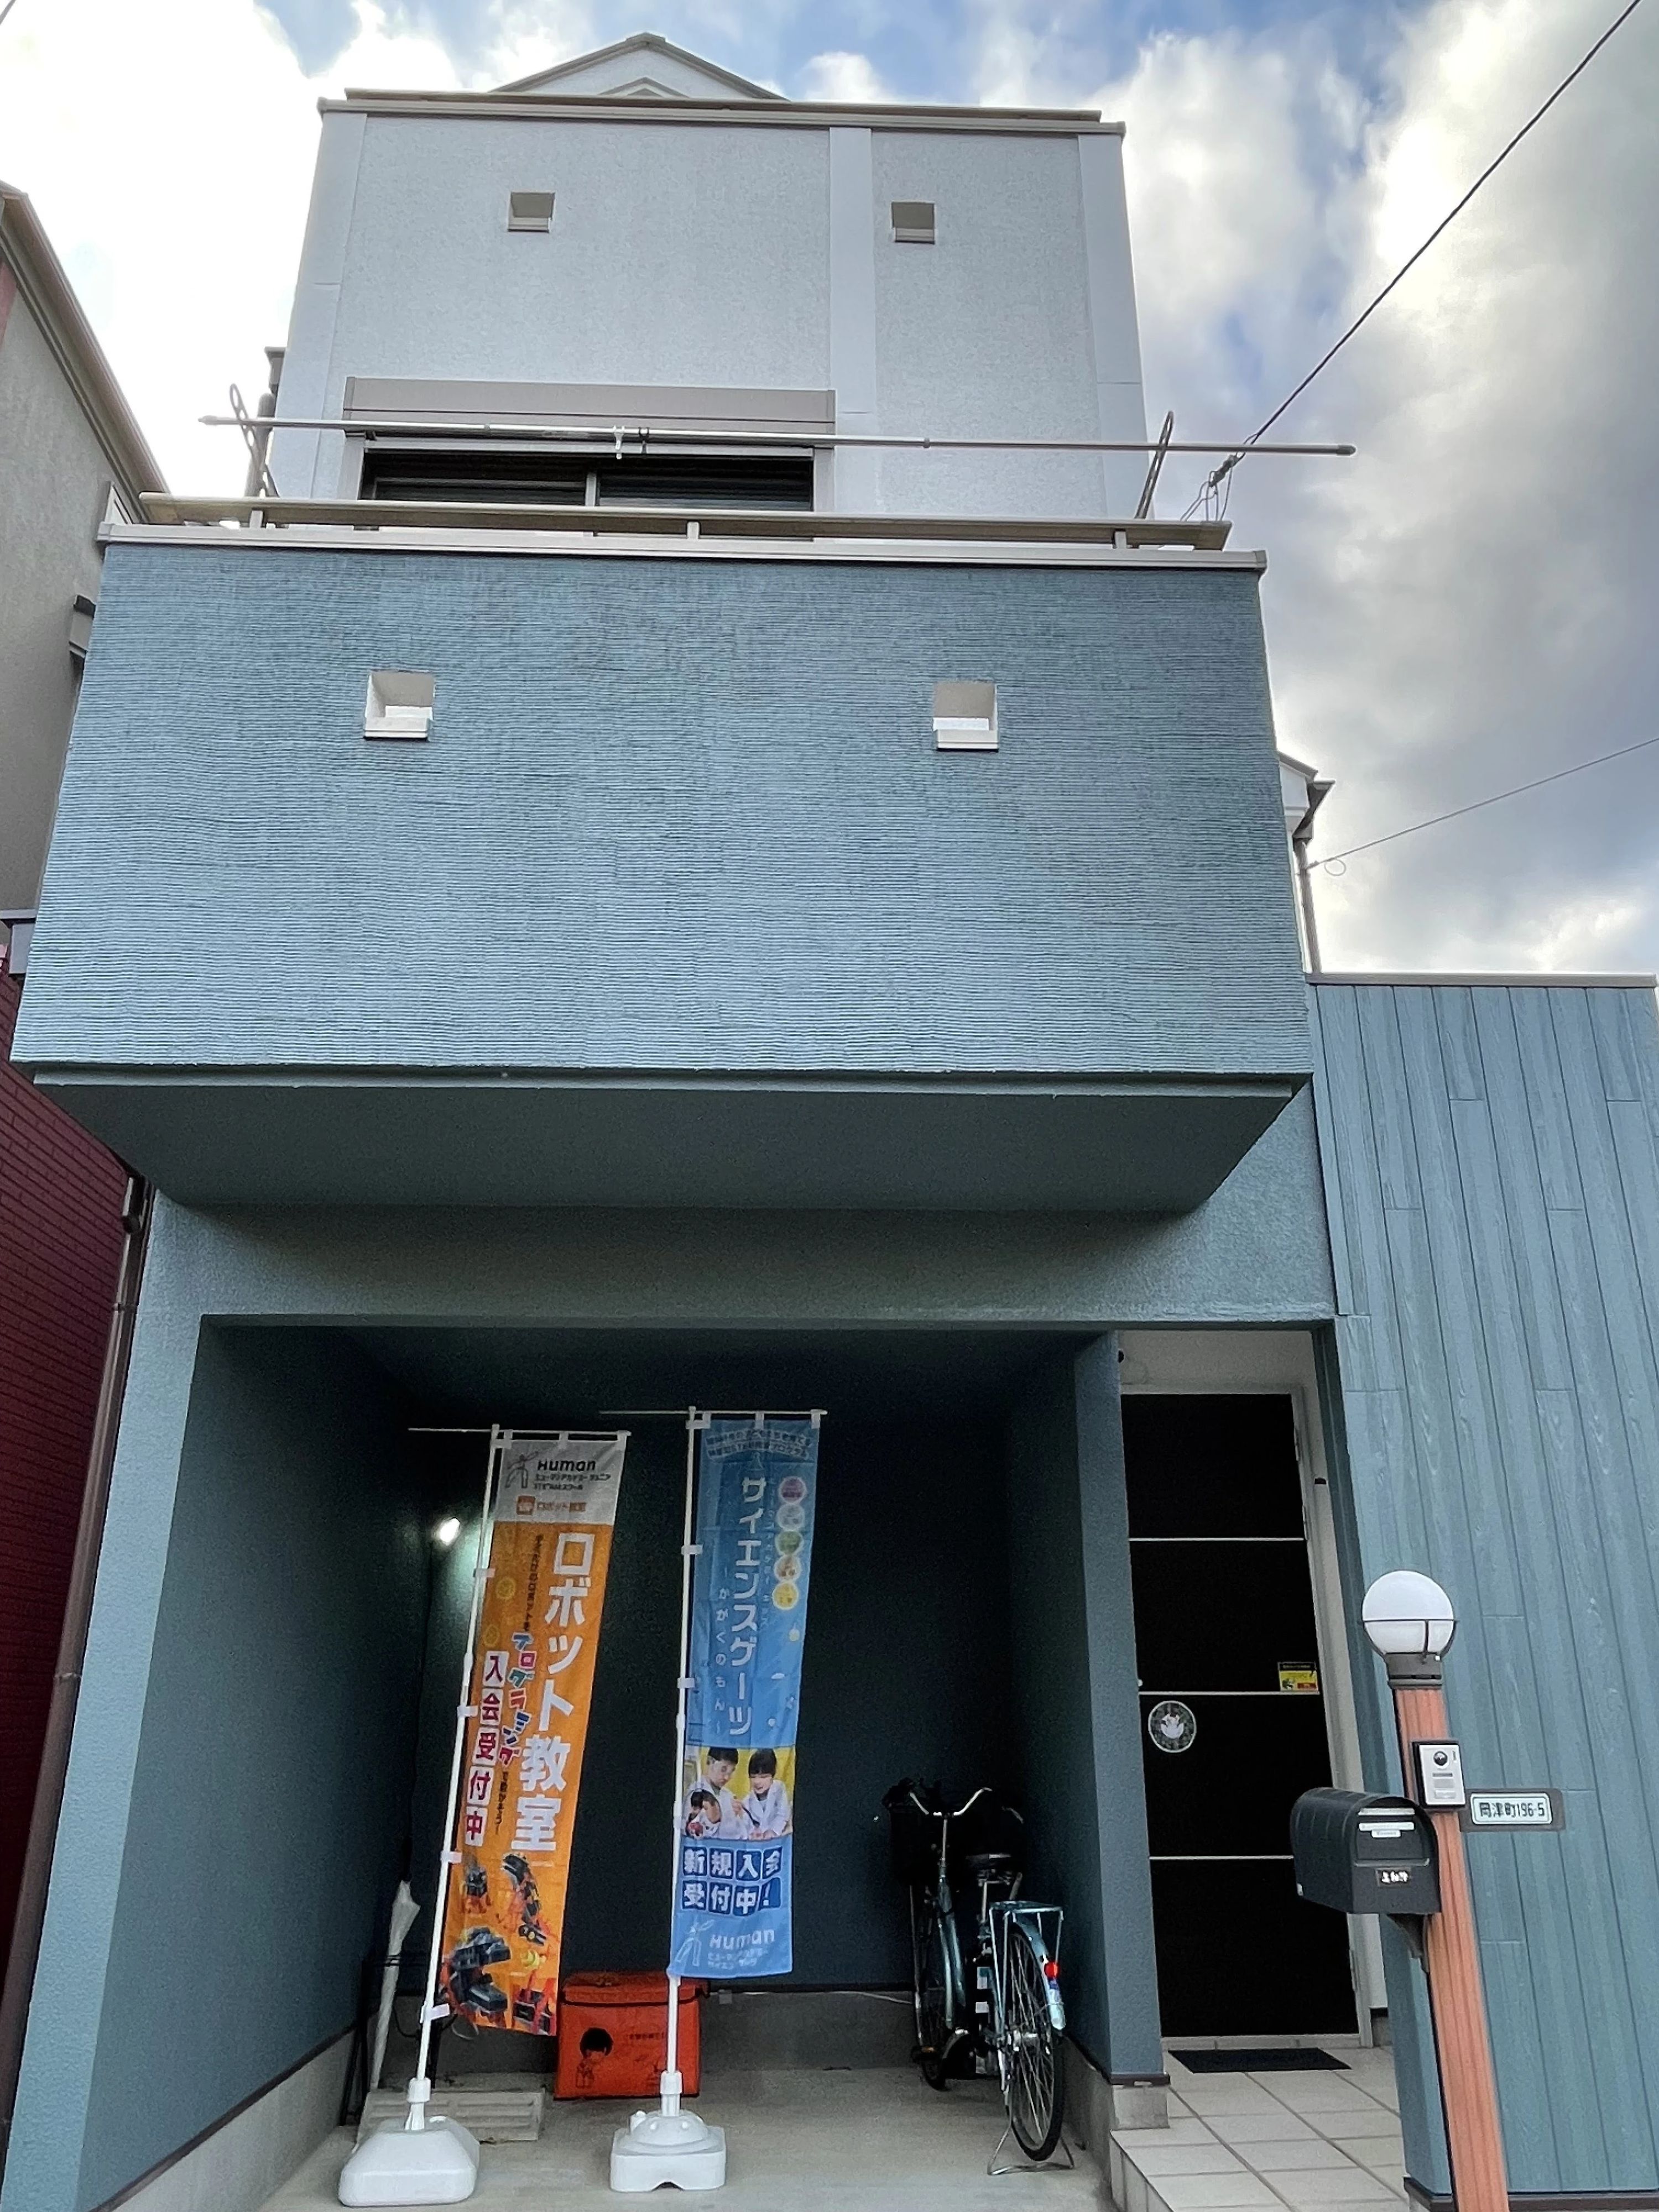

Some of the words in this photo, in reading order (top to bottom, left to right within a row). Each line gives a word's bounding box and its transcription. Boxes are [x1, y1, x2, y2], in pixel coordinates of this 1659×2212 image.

[538, 1459, 596, 1472] Human
[728, 1477, 767, 1736] サイエンスゲーツ
[499, 1632, 537, 1767] プログラミング
[511, 1533, 596, 1851] ロボット教室
[466, 1655, 504, 1841] 入会受付中
[684, 1849, 781, 1878] 新規入会
[684, 1882, 770, 1914] 受付中!
[709, 1929, 775, 1950] Human
